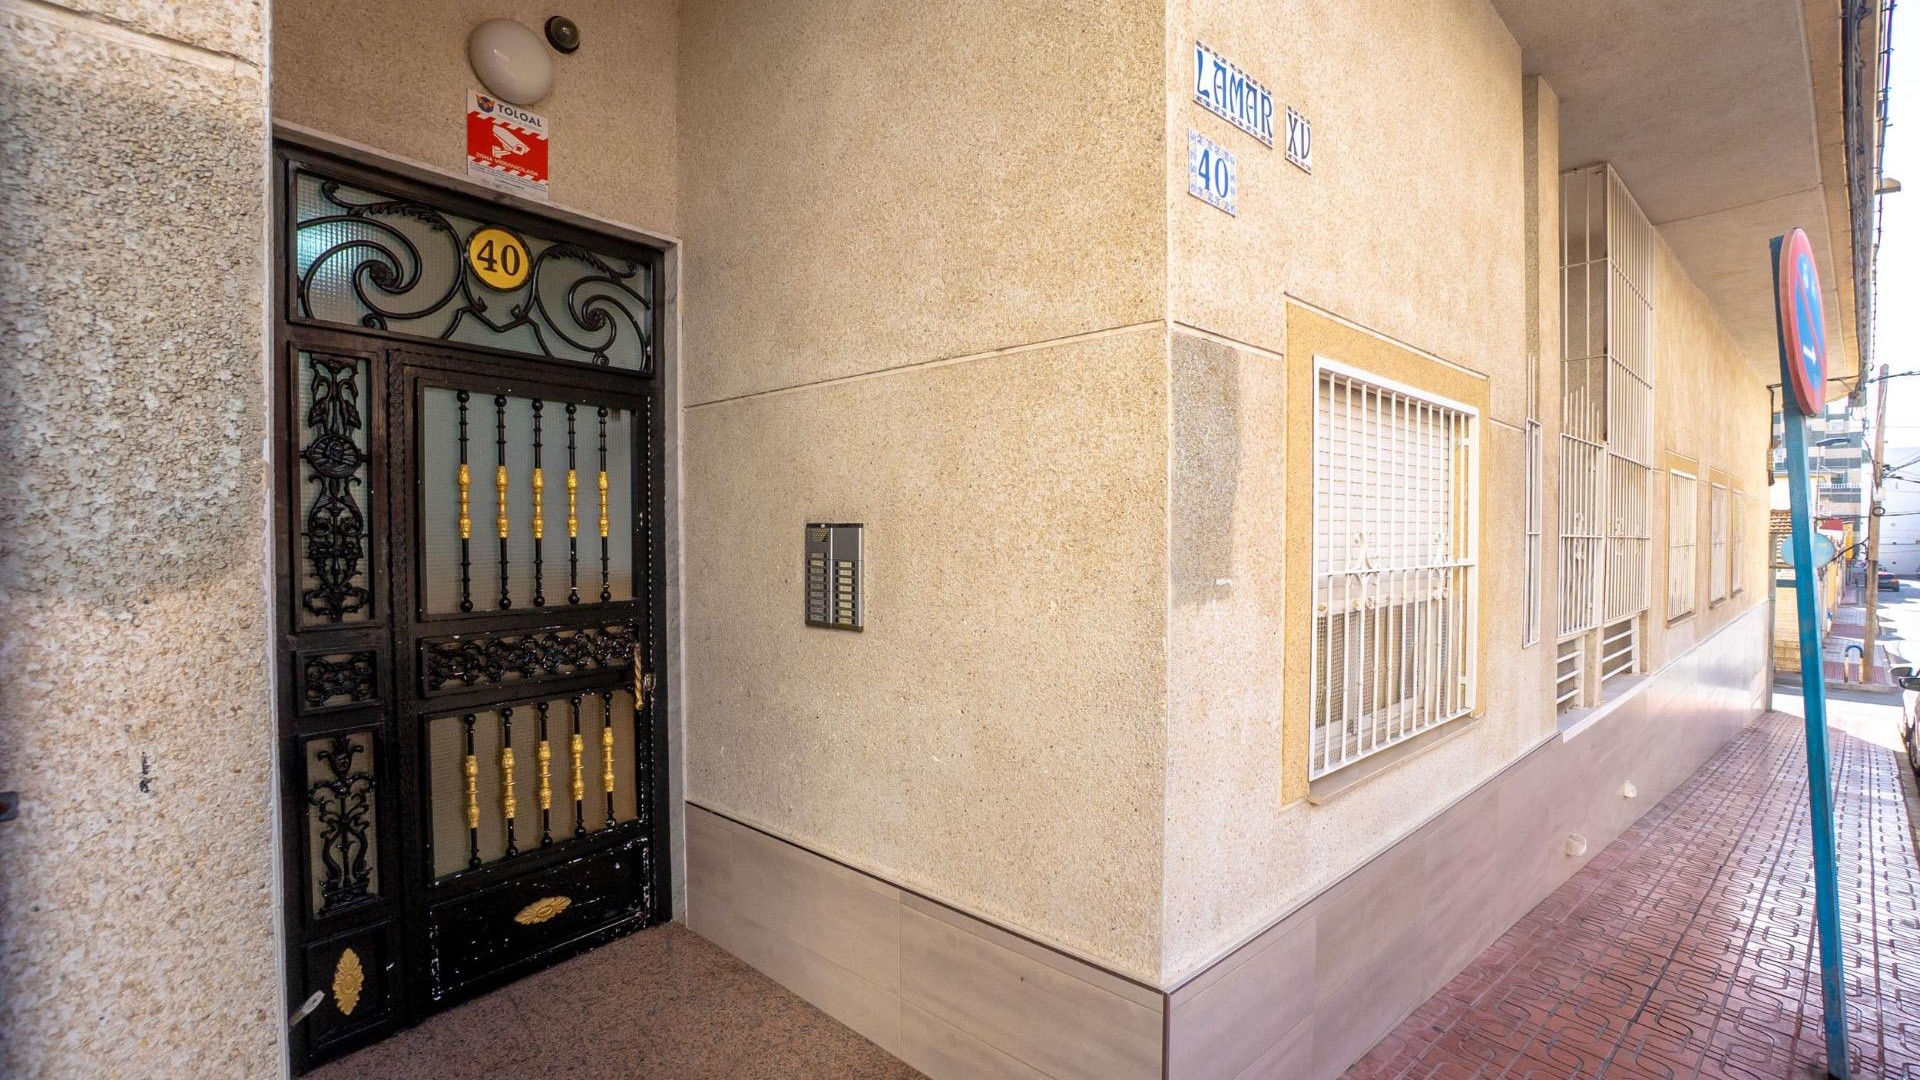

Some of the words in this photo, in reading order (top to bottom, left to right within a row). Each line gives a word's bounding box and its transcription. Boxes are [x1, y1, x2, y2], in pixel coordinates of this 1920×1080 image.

[1197, 48, 1273, 139] LAMAR
[498, 104, 542, 127] TOLOAL
[475, 152, 493, 162] ZONA
[1198, 148, 1229, 198] 40
[477, 240, 521, 276] 40
